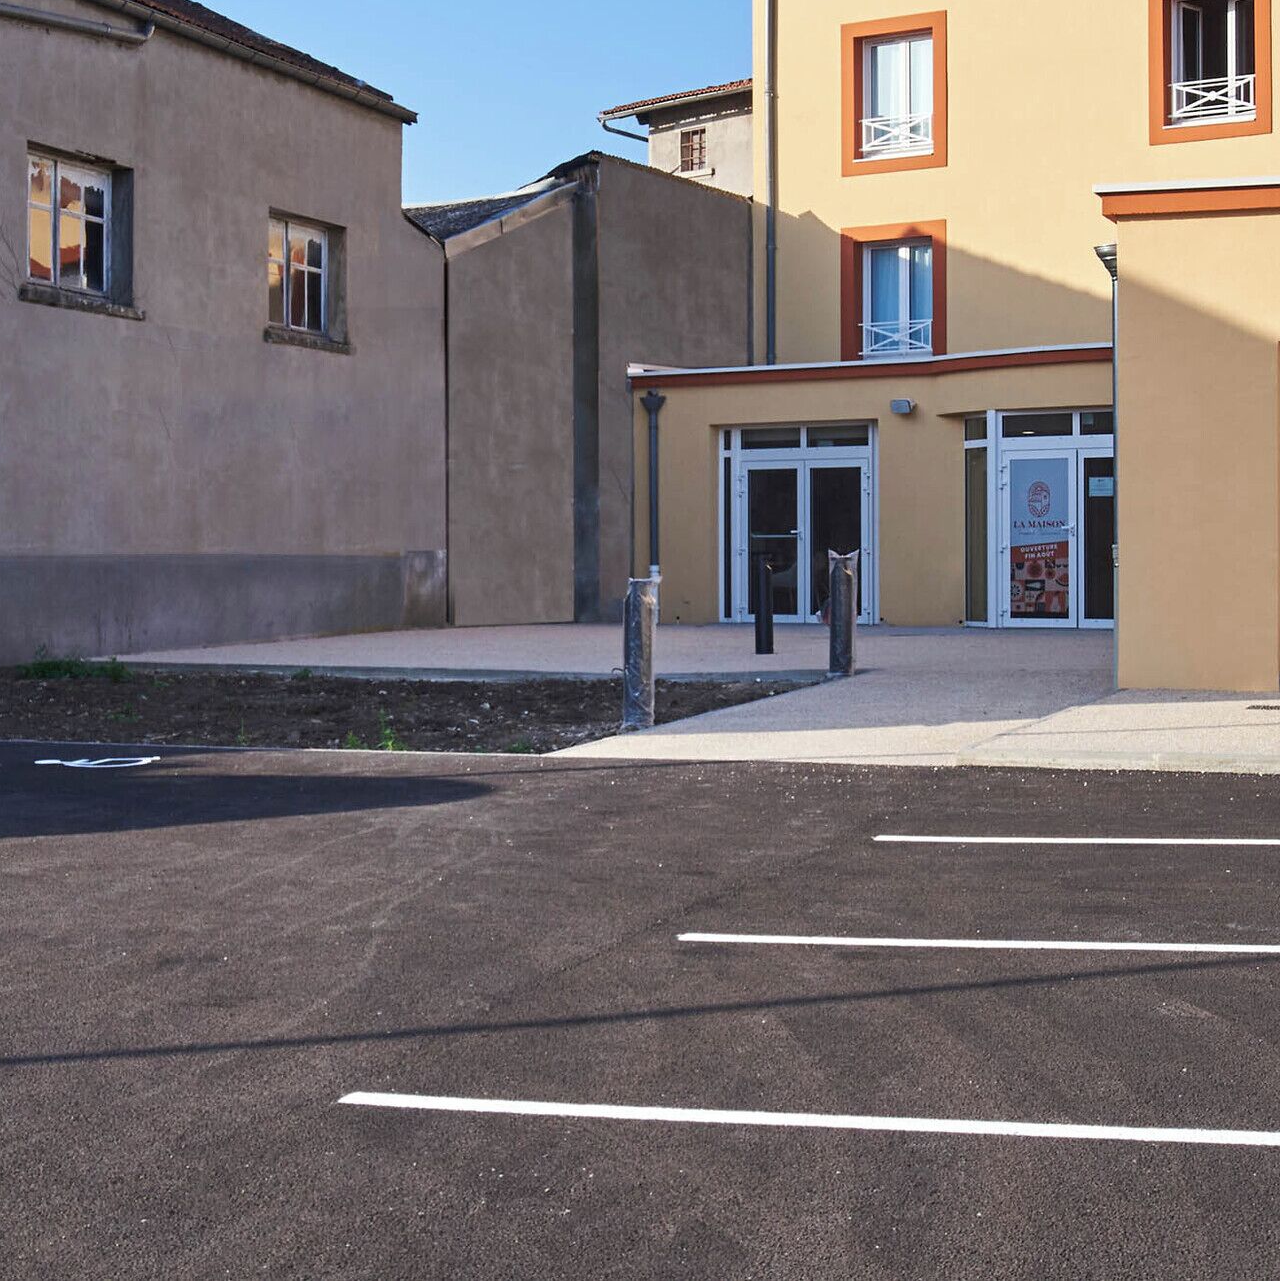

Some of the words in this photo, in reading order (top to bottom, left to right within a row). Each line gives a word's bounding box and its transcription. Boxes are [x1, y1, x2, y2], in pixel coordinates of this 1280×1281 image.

[1014, 520, 1025, 528] LA
[1028, 520, 1065, 528] MAISON
[1020, 544, 1057, 553] OUVERTURE
